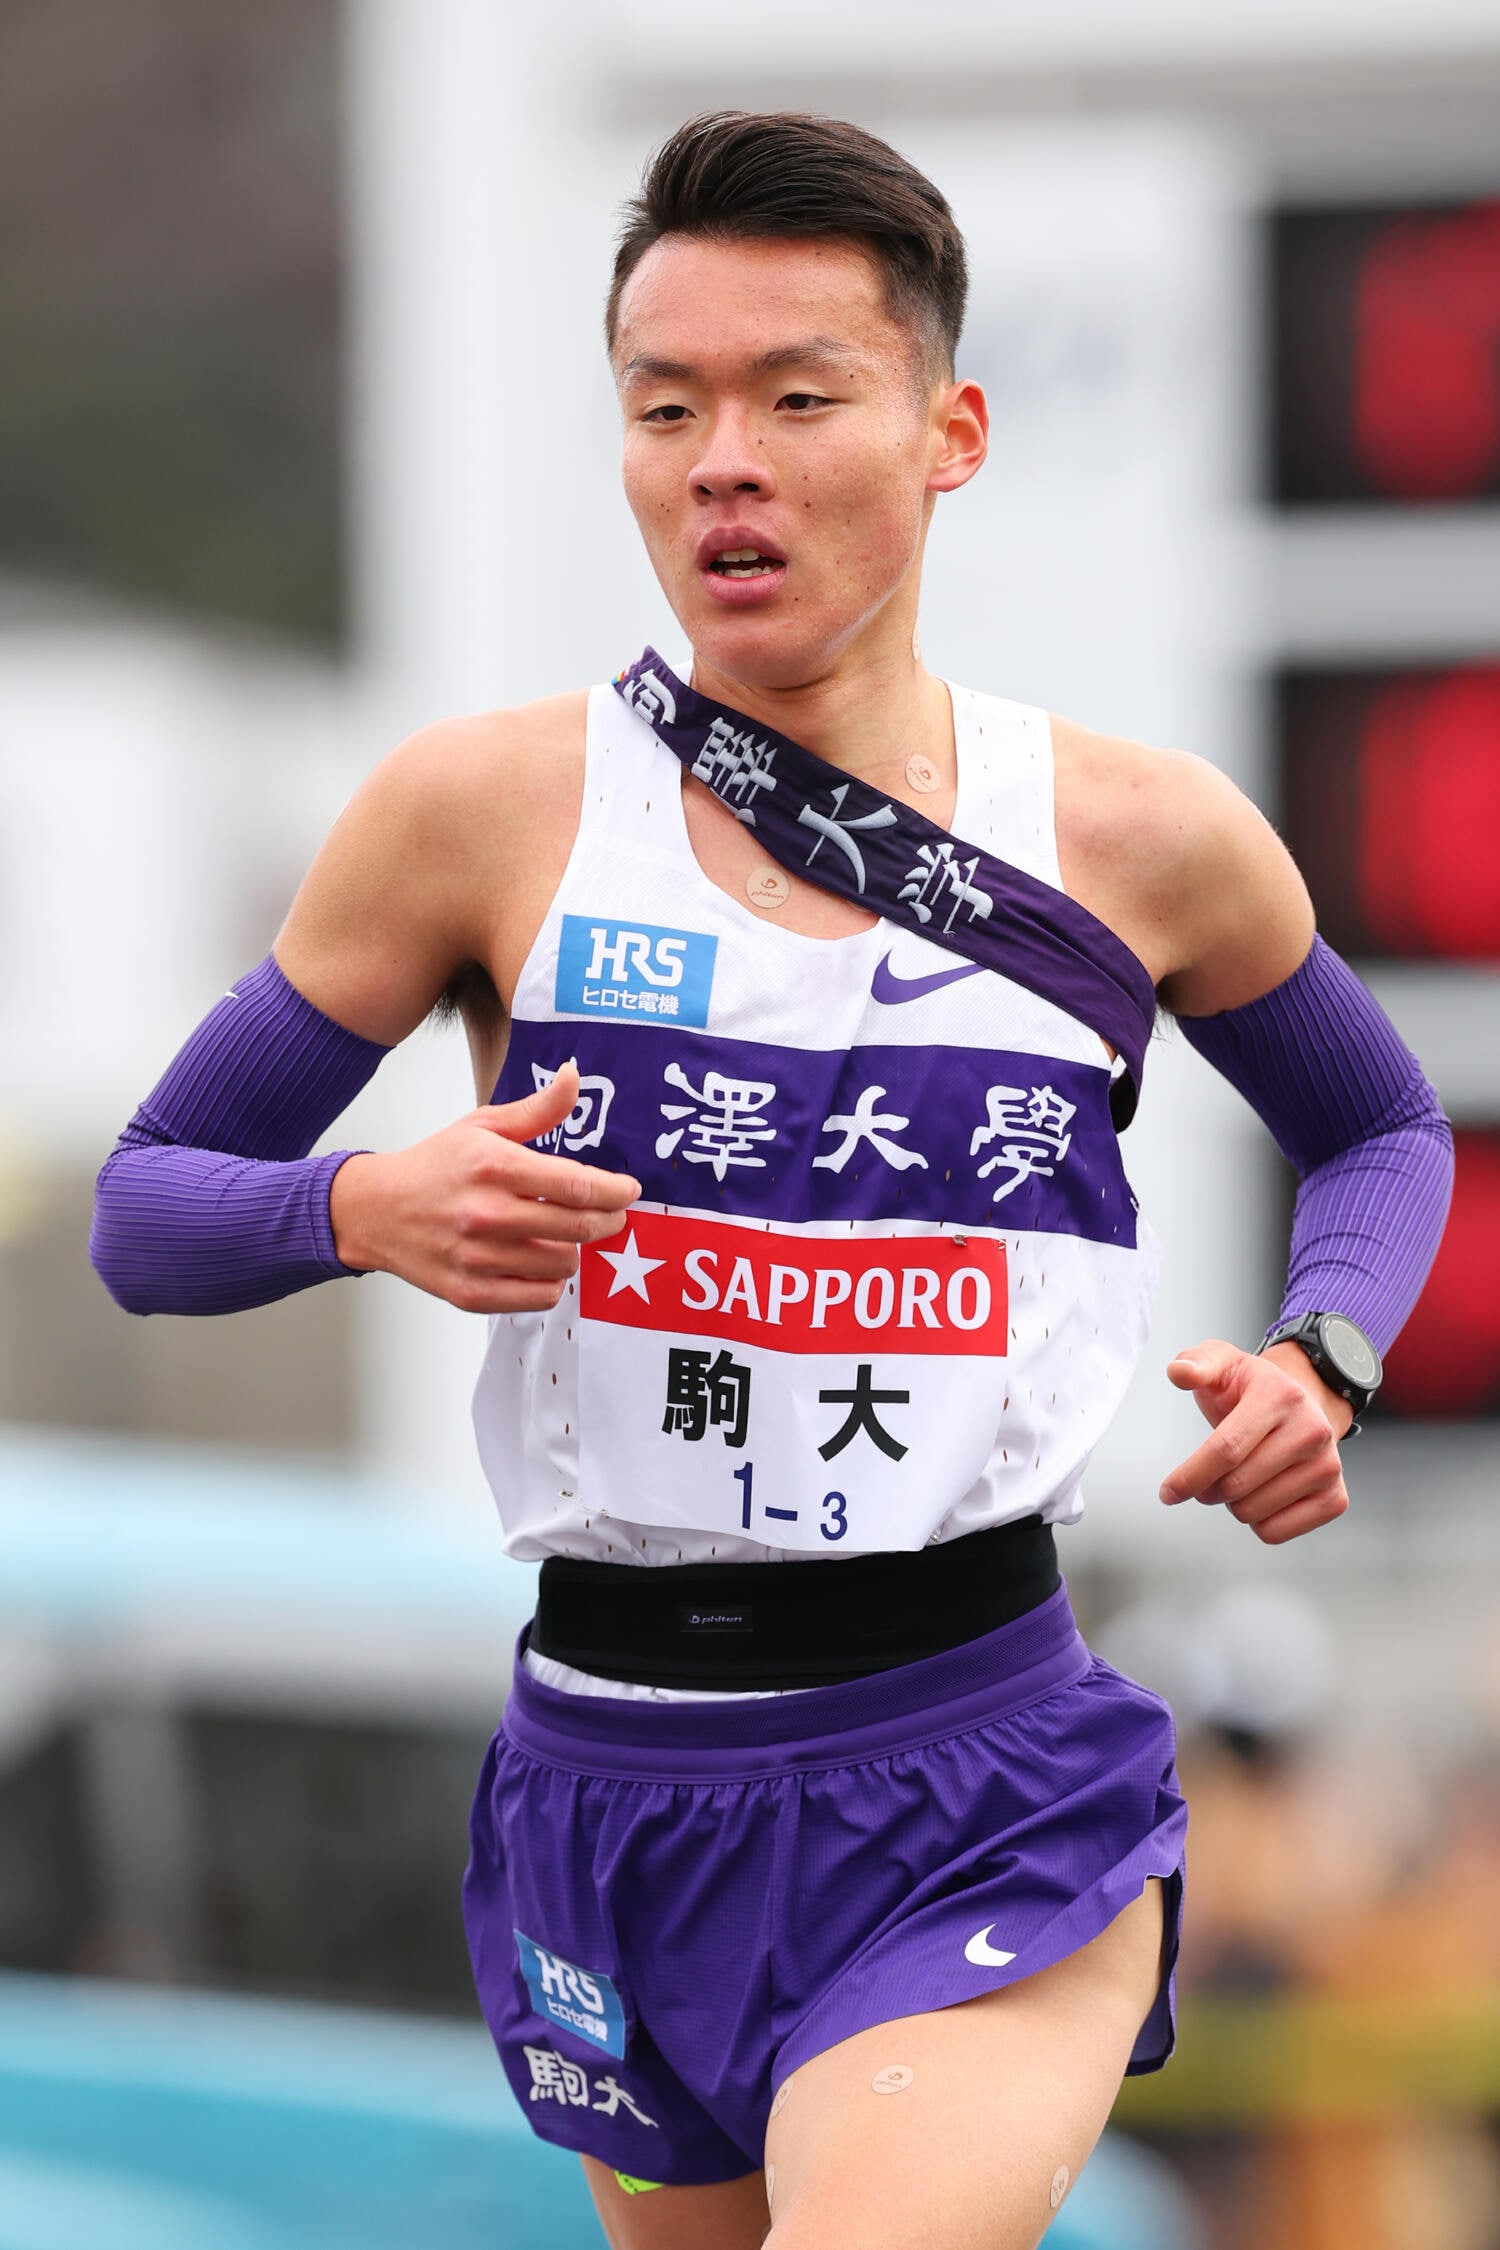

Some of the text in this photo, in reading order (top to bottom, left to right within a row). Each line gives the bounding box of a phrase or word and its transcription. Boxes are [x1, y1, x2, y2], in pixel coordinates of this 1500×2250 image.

[585, 927, 688, 988] HRS
[582, 985, 680, 1016] ヒロセ電機
[681, 1248, 992, 1331] SAPPORO
[534, 1948, 605, 2015] HRS
[523, 2045, 660, 2129] 駒大
